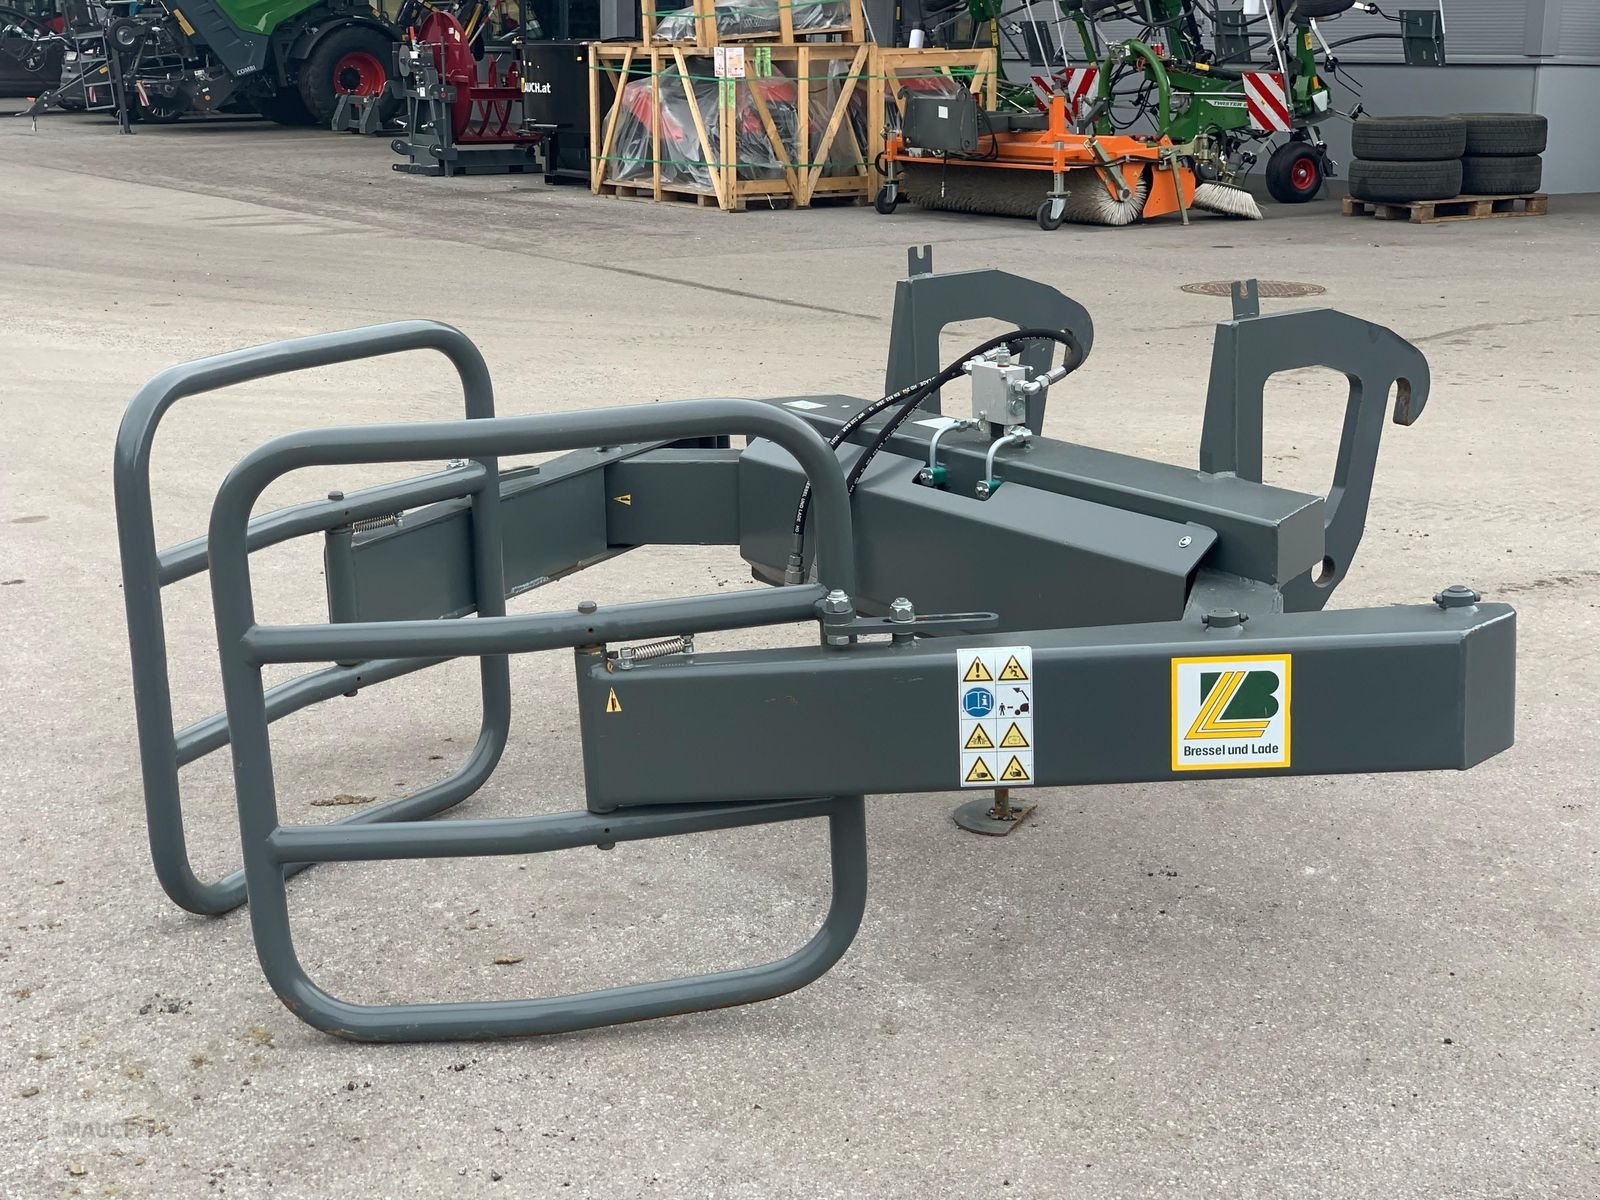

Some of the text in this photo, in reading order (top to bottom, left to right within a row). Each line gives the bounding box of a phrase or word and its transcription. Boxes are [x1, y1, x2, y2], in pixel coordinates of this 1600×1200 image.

[236, 65, 257, 76] COMBI
[1184, 743, 1279, 756] Bressel und Lade
